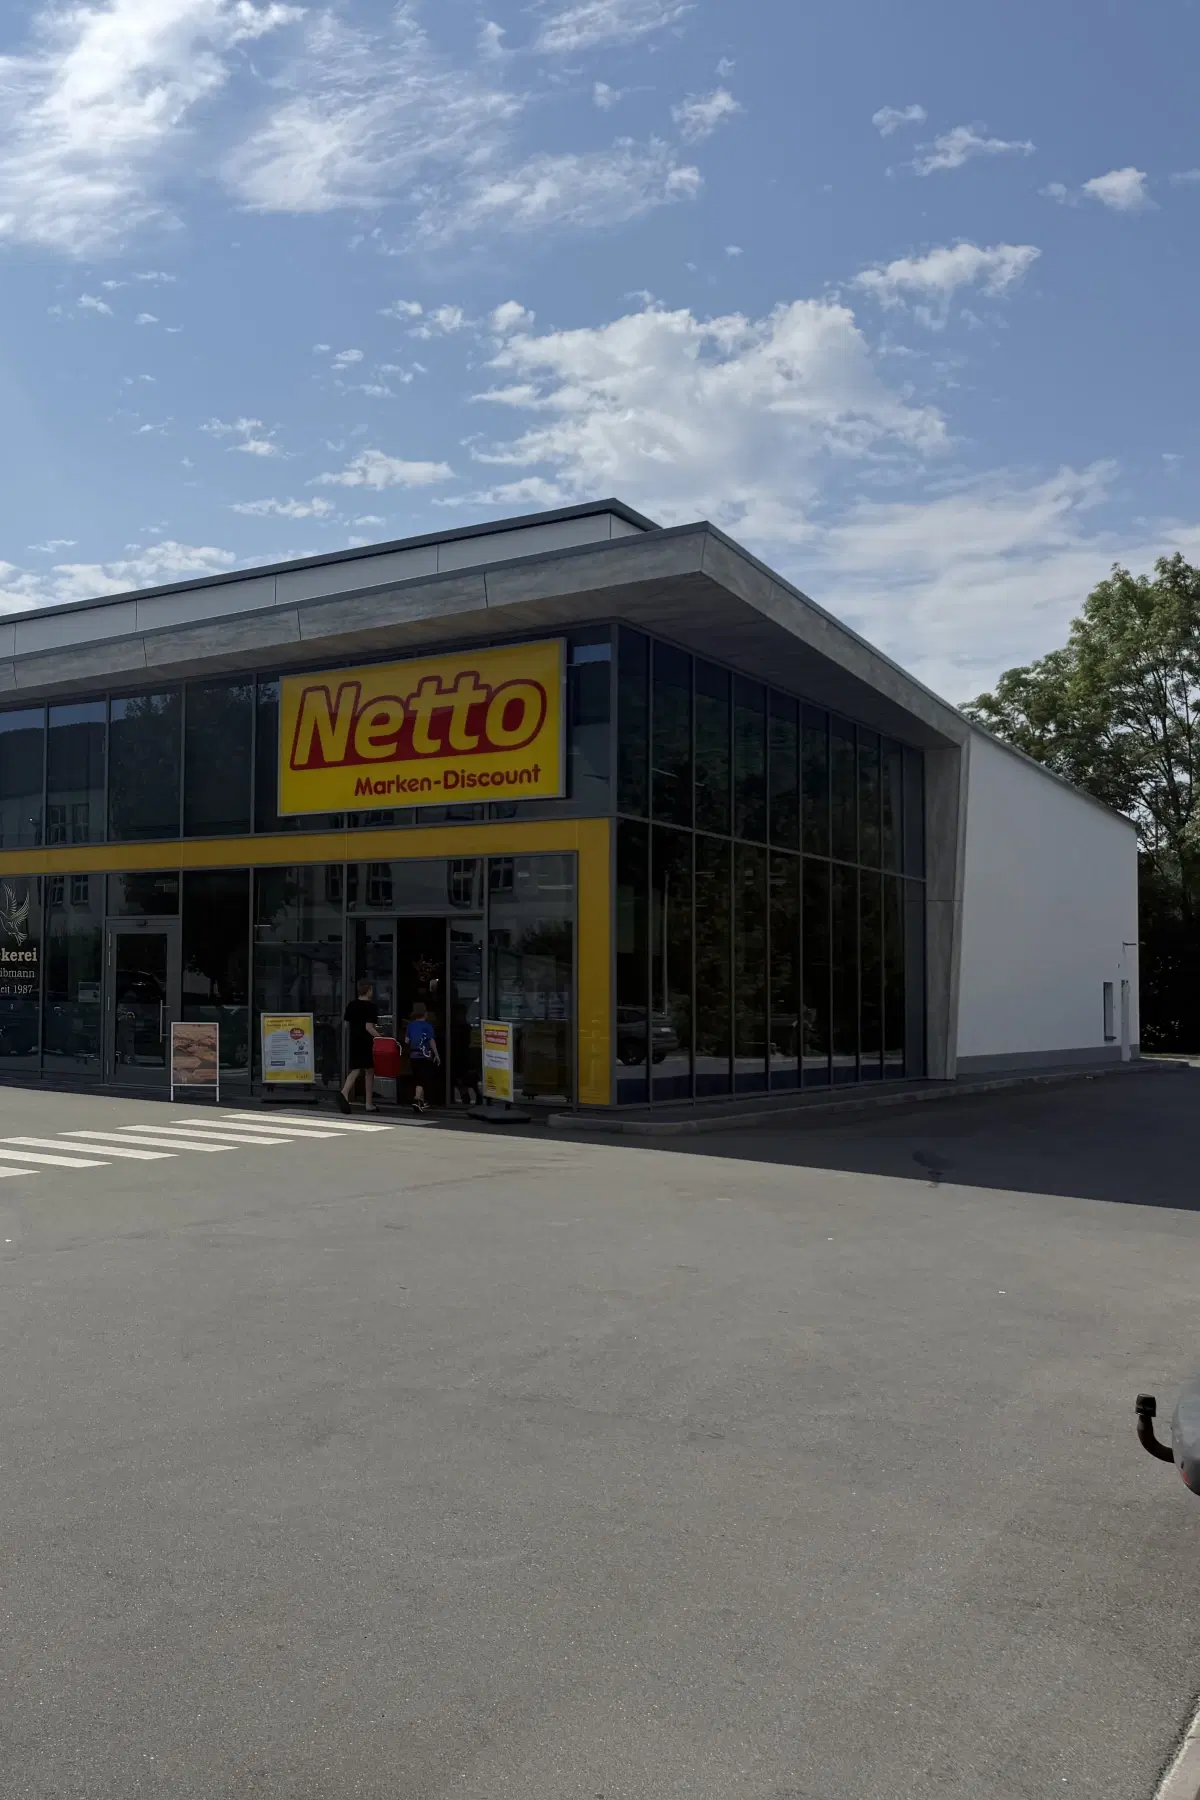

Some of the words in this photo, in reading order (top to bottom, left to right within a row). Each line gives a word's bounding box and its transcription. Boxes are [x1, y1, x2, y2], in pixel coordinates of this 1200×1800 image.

[290, 671, 547, 771] Netto
[354, 763, 542, 797] Marken-Discount
[12, 984, 34, 995] 1987
